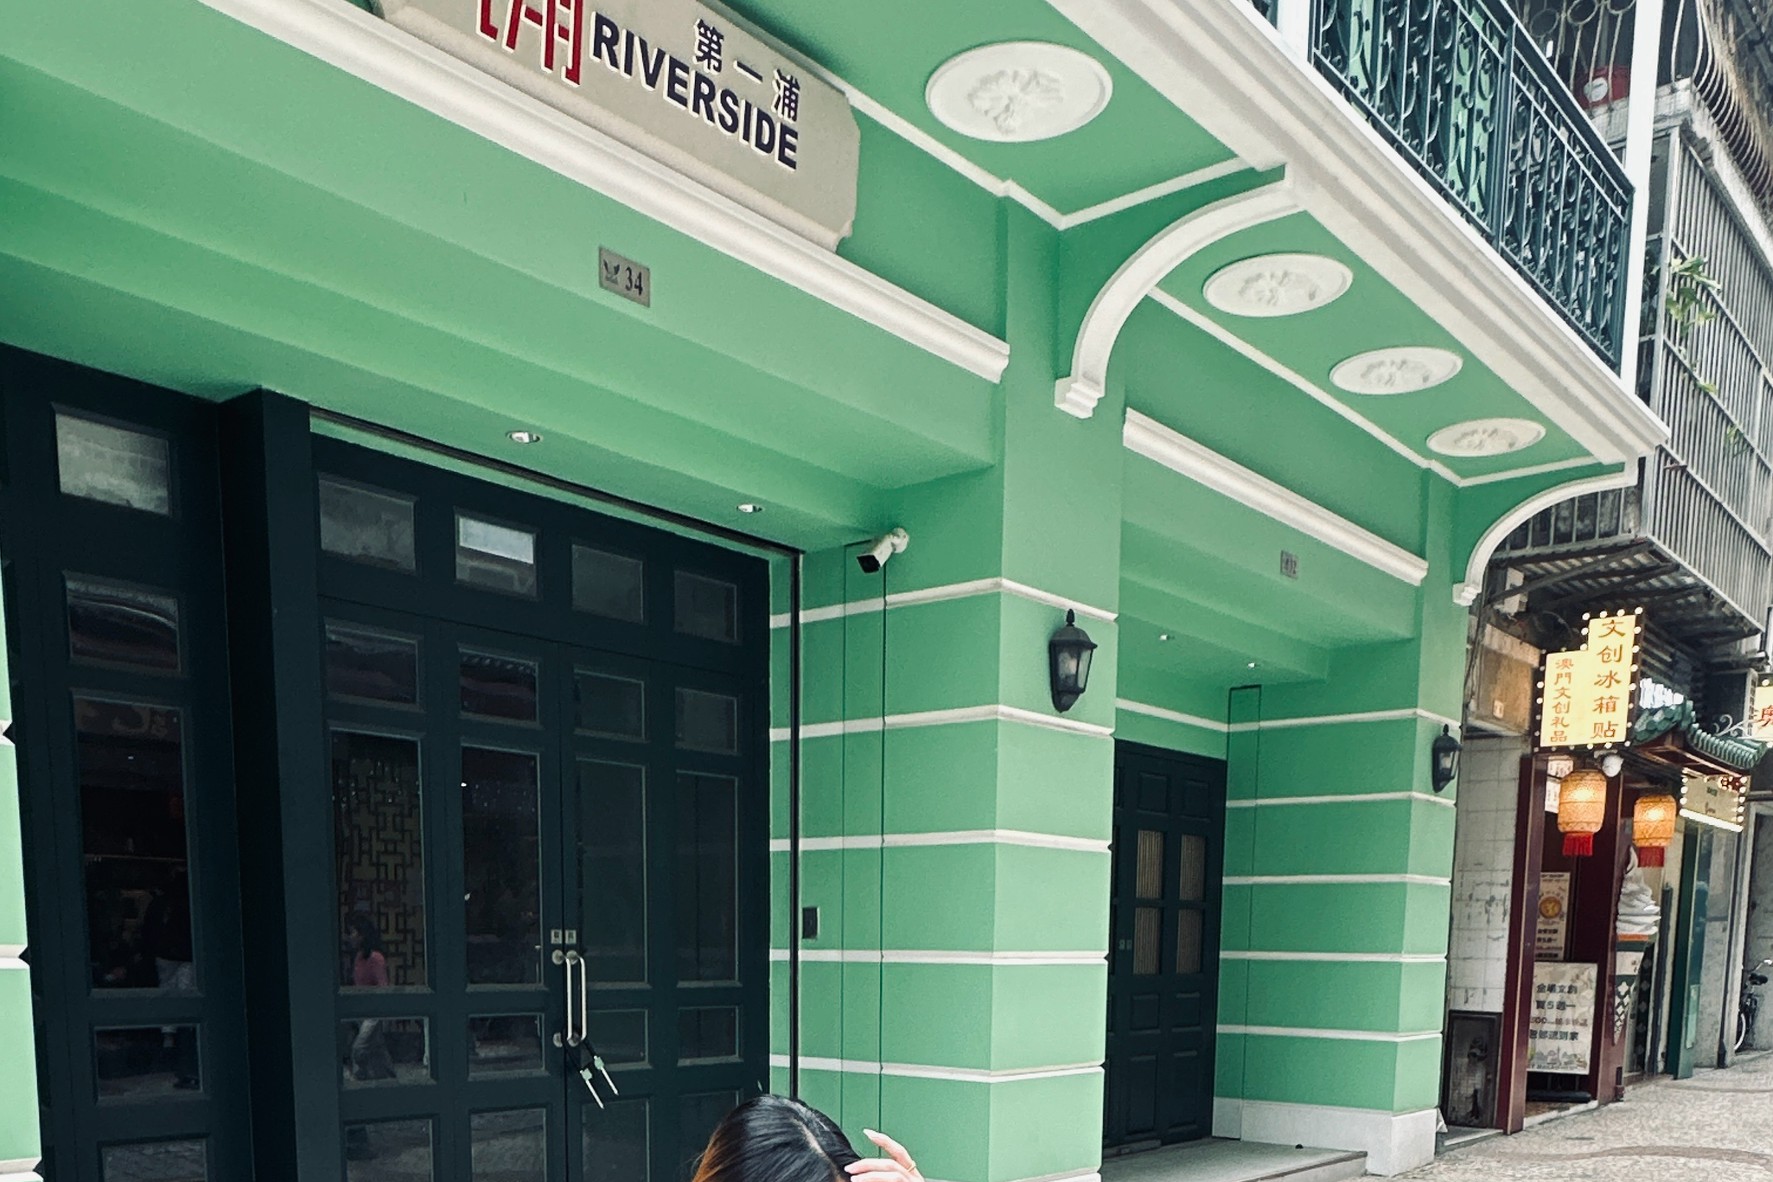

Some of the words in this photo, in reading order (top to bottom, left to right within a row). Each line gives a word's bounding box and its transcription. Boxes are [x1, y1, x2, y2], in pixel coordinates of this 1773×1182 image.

[590, 11, 799, 171] RIVERSIDE
[694, 18, 801, 122] 第一浦
[625, 266, 643, 296] 34
[1549, 657, 1574, 743] 澳門文创礼品
[1590, 619, 1626, 740] 文创冰箱贴
